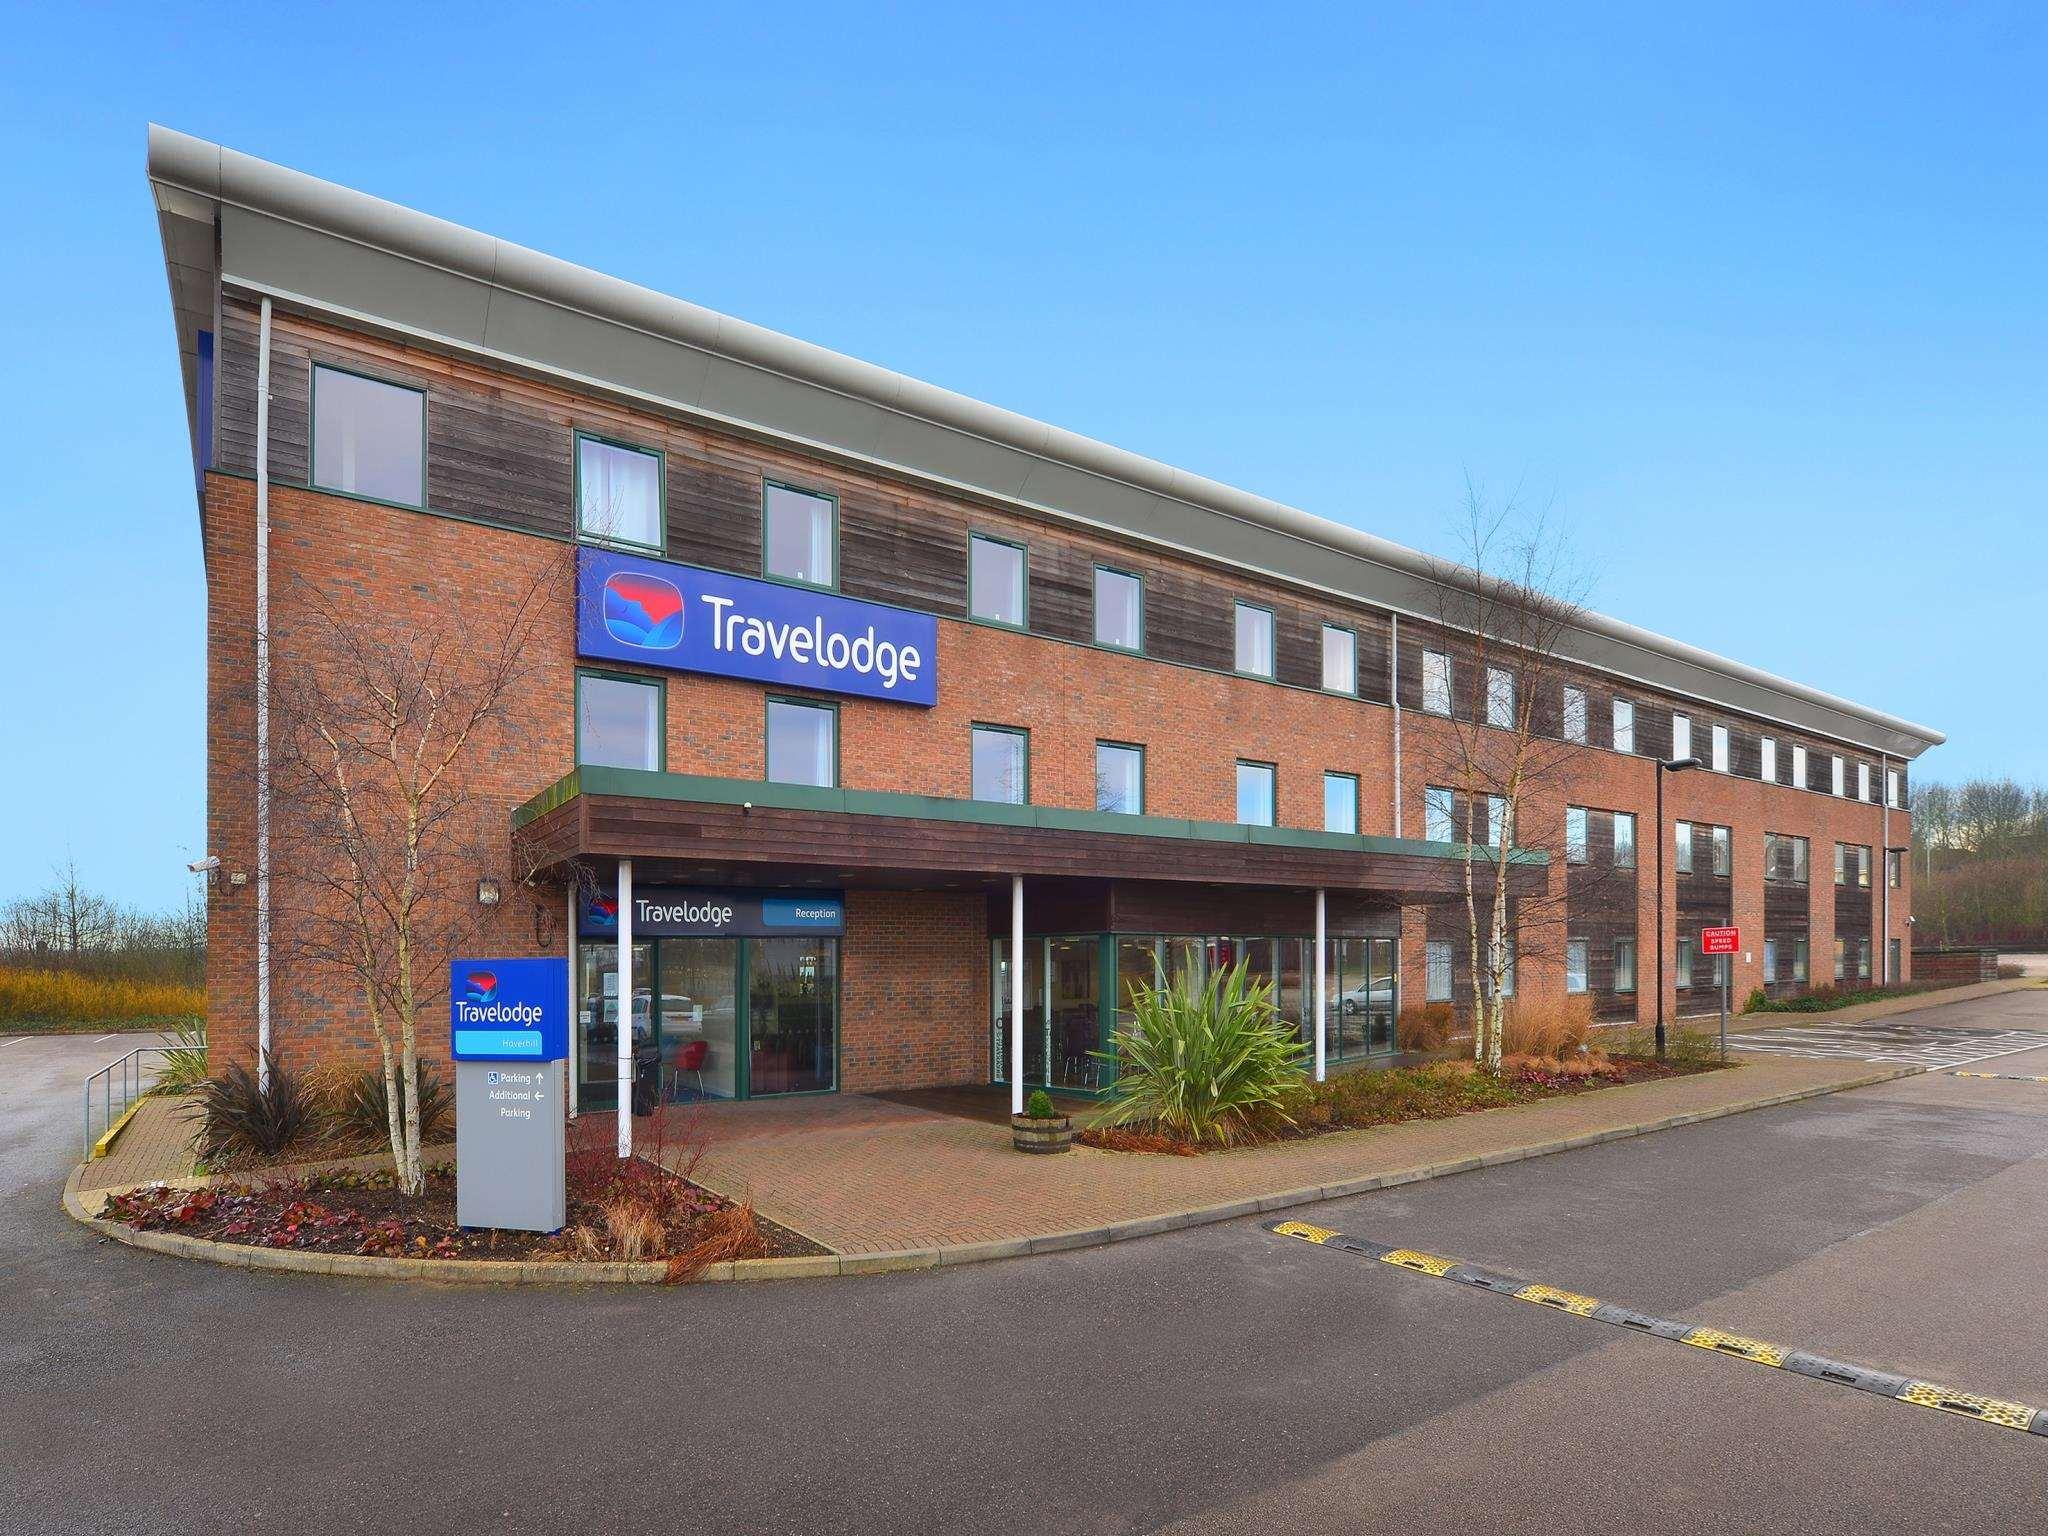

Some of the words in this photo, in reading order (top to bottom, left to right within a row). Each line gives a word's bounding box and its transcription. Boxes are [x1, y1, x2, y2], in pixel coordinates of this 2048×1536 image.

[701, 594, 922, 689] Travelodge
[635, 899, 733, 928] Travelodge
[795, 908, 836, 920] Reception
[455, 1001, 543, 1027] Travelodge
[500, 1073, 531, 1085] Parking
[489, 1090, 531, 1100] Additional
[500, 1107, 531, 1120] Parking
